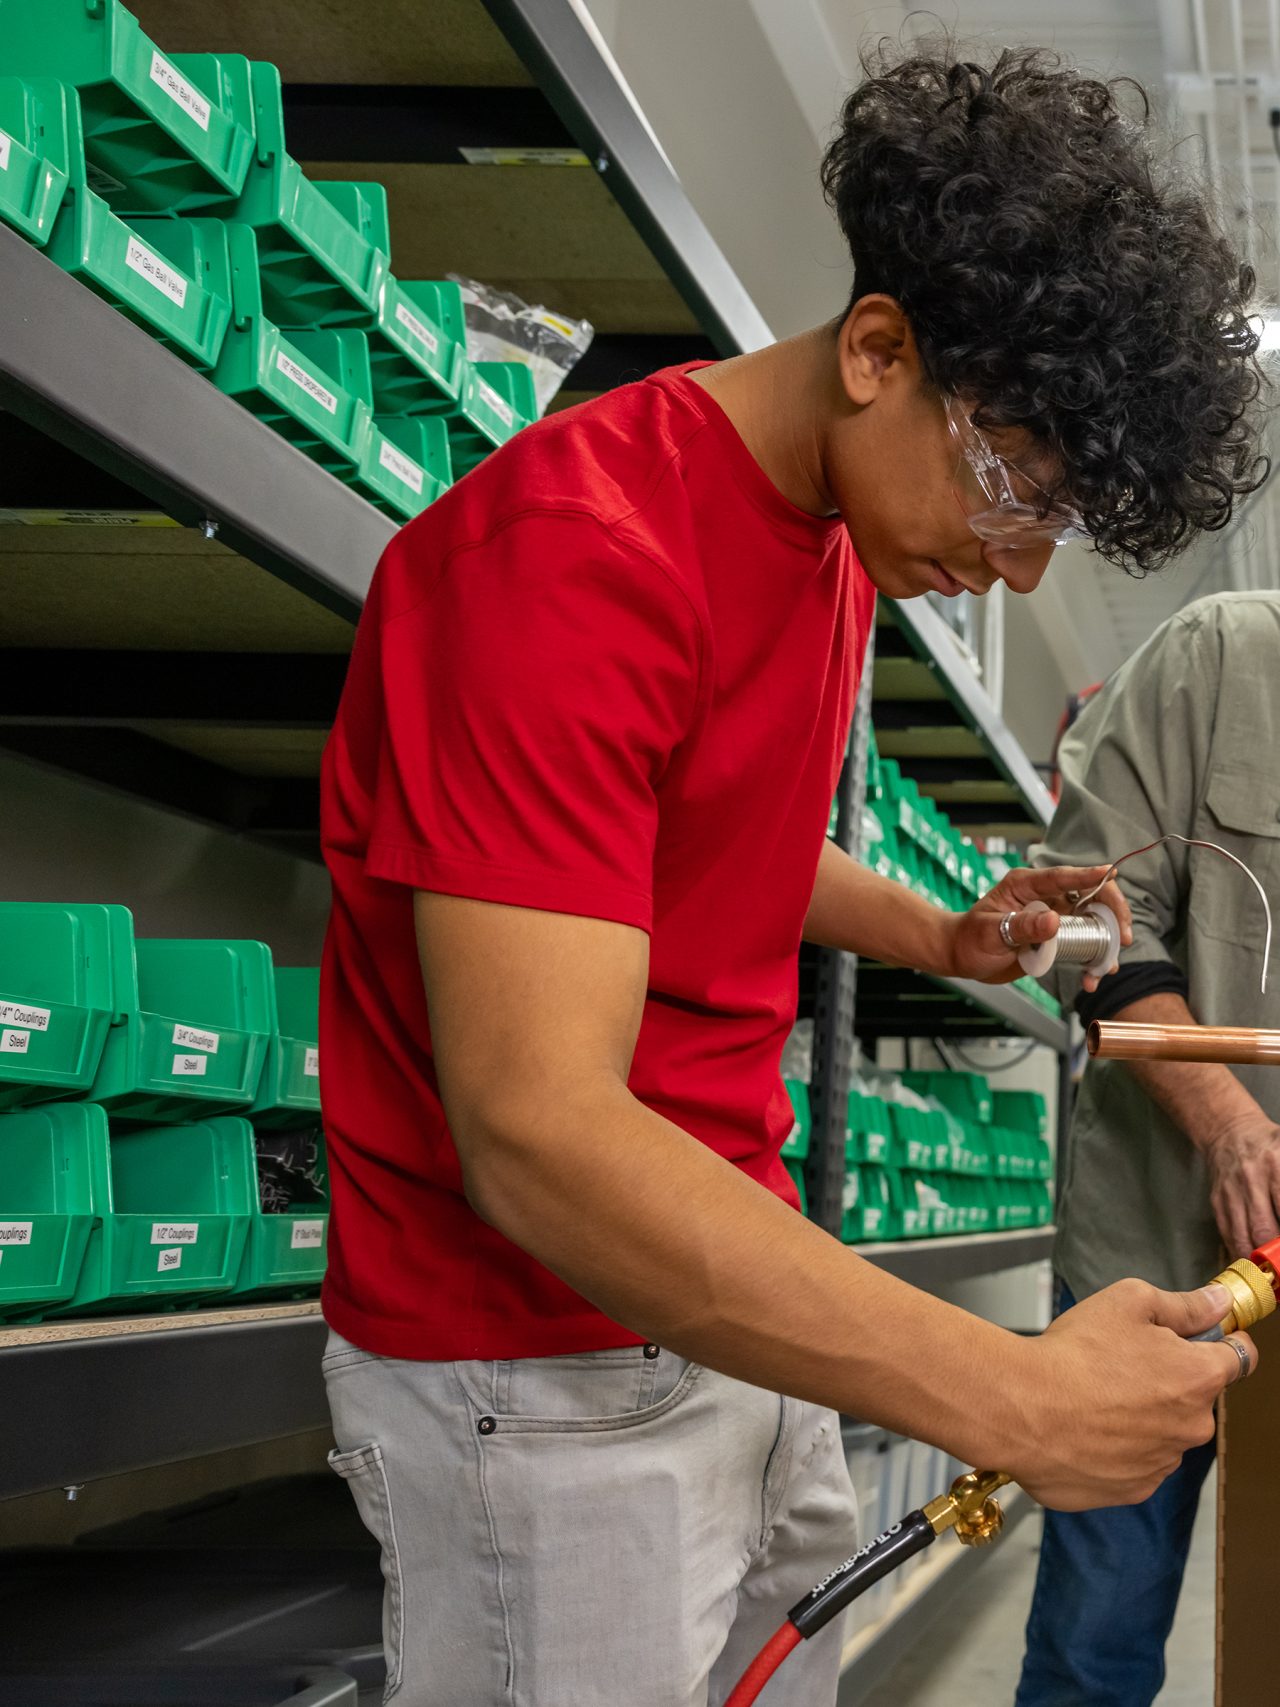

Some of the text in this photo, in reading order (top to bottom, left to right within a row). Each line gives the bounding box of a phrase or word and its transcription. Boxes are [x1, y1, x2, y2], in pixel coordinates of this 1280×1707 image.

[167, 75, 179, 93] Gas
[179, 87, 191, 103] Ball
[191, 98, 206, 120] Valve
[131, 247, 183, 298] 1/2" Gas Ball Valve
[14, 1008, 47, 1027] Couplings
[9, 1034, 27, 1048] Steel
[189, 1032, 214, 1049] Couplings
[184, 1059, 198, 1070] Steel
[157, 1227, 195, 1241] 1/2" Couplings
[164, 1252, 178, 1266] Steel
